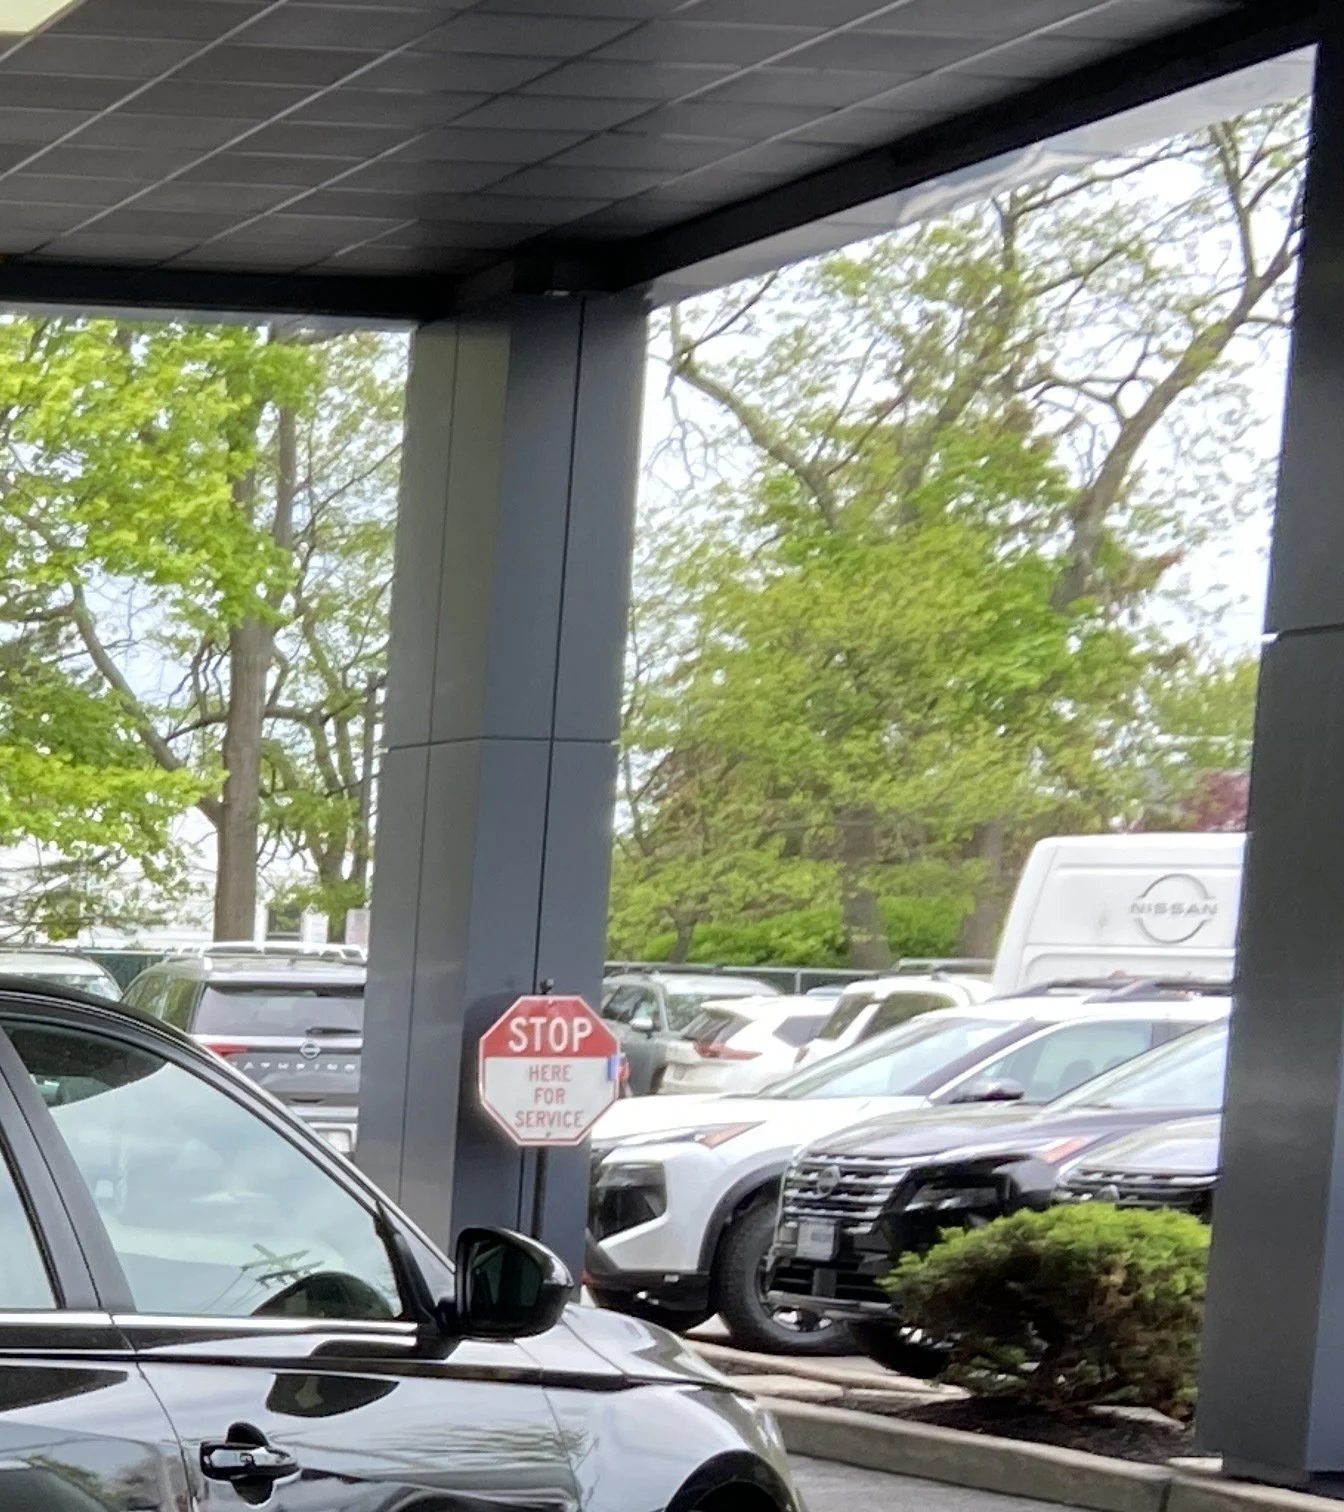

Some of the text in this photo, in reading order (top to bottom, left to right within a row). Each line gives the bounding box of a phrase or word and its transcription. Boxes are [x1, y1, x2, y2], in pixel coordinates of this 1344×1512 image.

[1129, 902, 1217, 915] NISSAN
[508, 1016, 593, 1053] STOP
[528, 1063, 572, 1082] HERE
[533, 1087, 566, 1105] FOR
[514, 1110, 585, 1128] SERVICE
